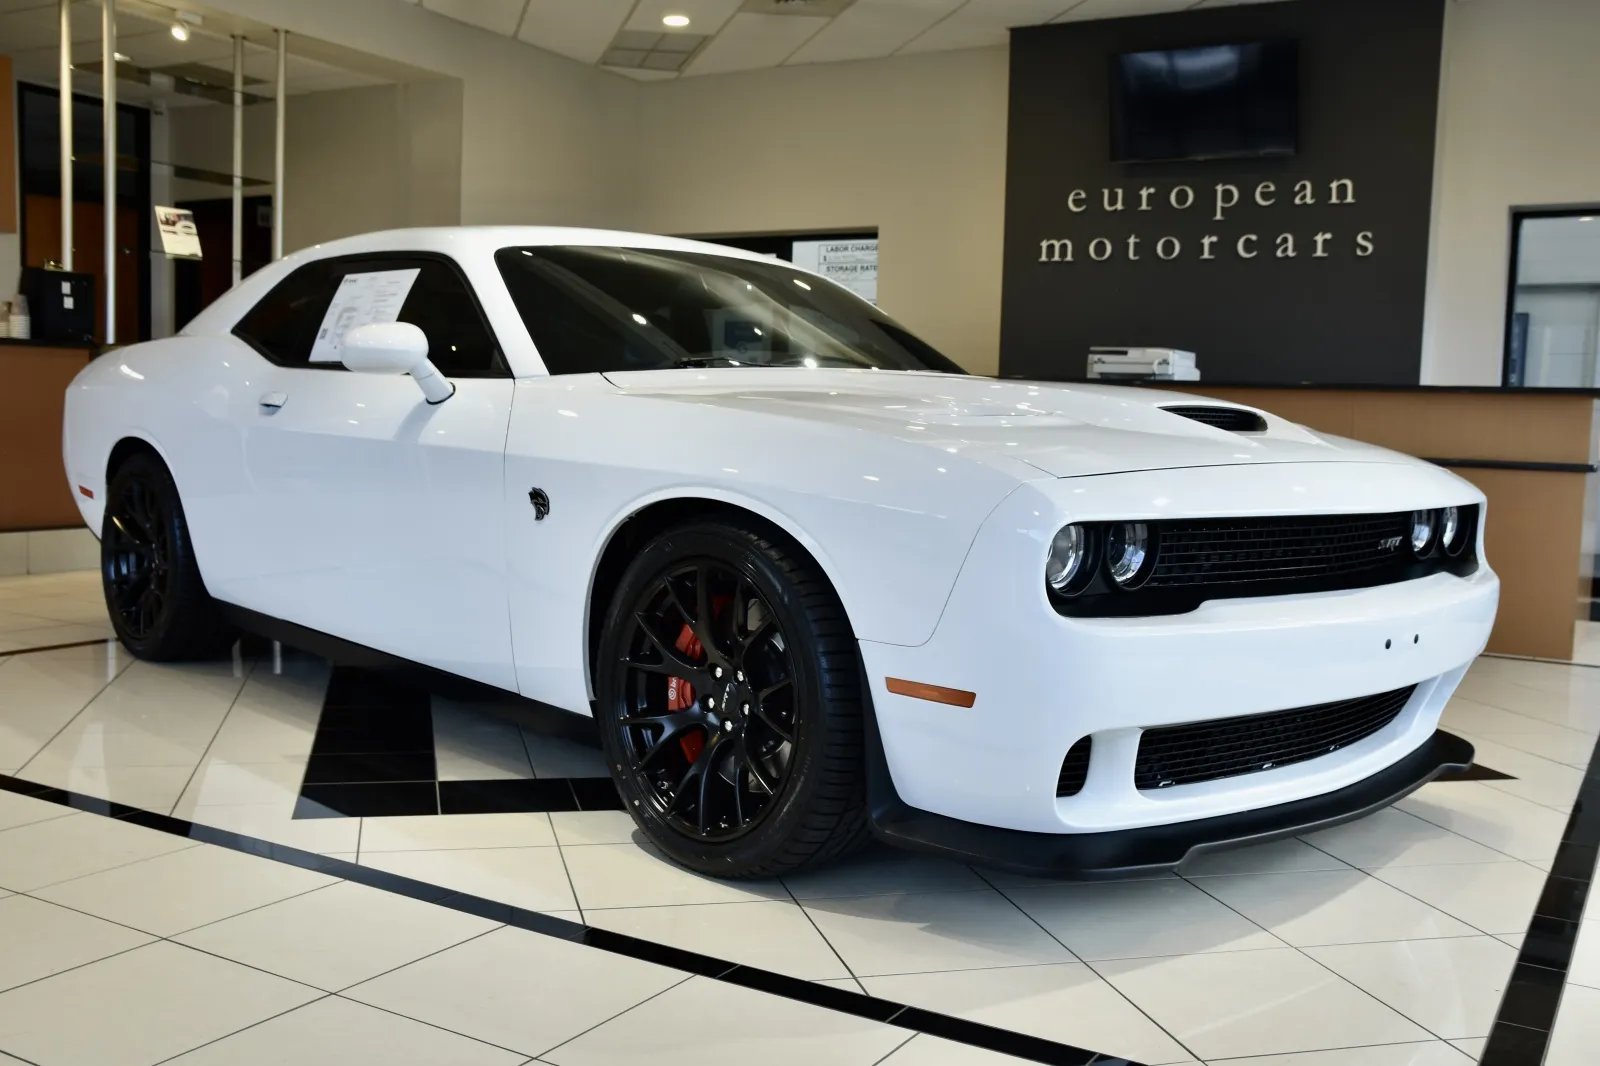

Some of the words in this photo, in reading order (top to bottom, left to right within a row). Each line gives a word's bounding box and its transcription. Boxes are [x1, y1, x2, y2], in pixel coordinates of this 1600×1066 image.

[1067, 176, 1356, 220] european
[826, 245, 849, 253] LABOR
[1038, 229, 1375, 262] motorcars
[826, 265, 858, 273] STORAGE
